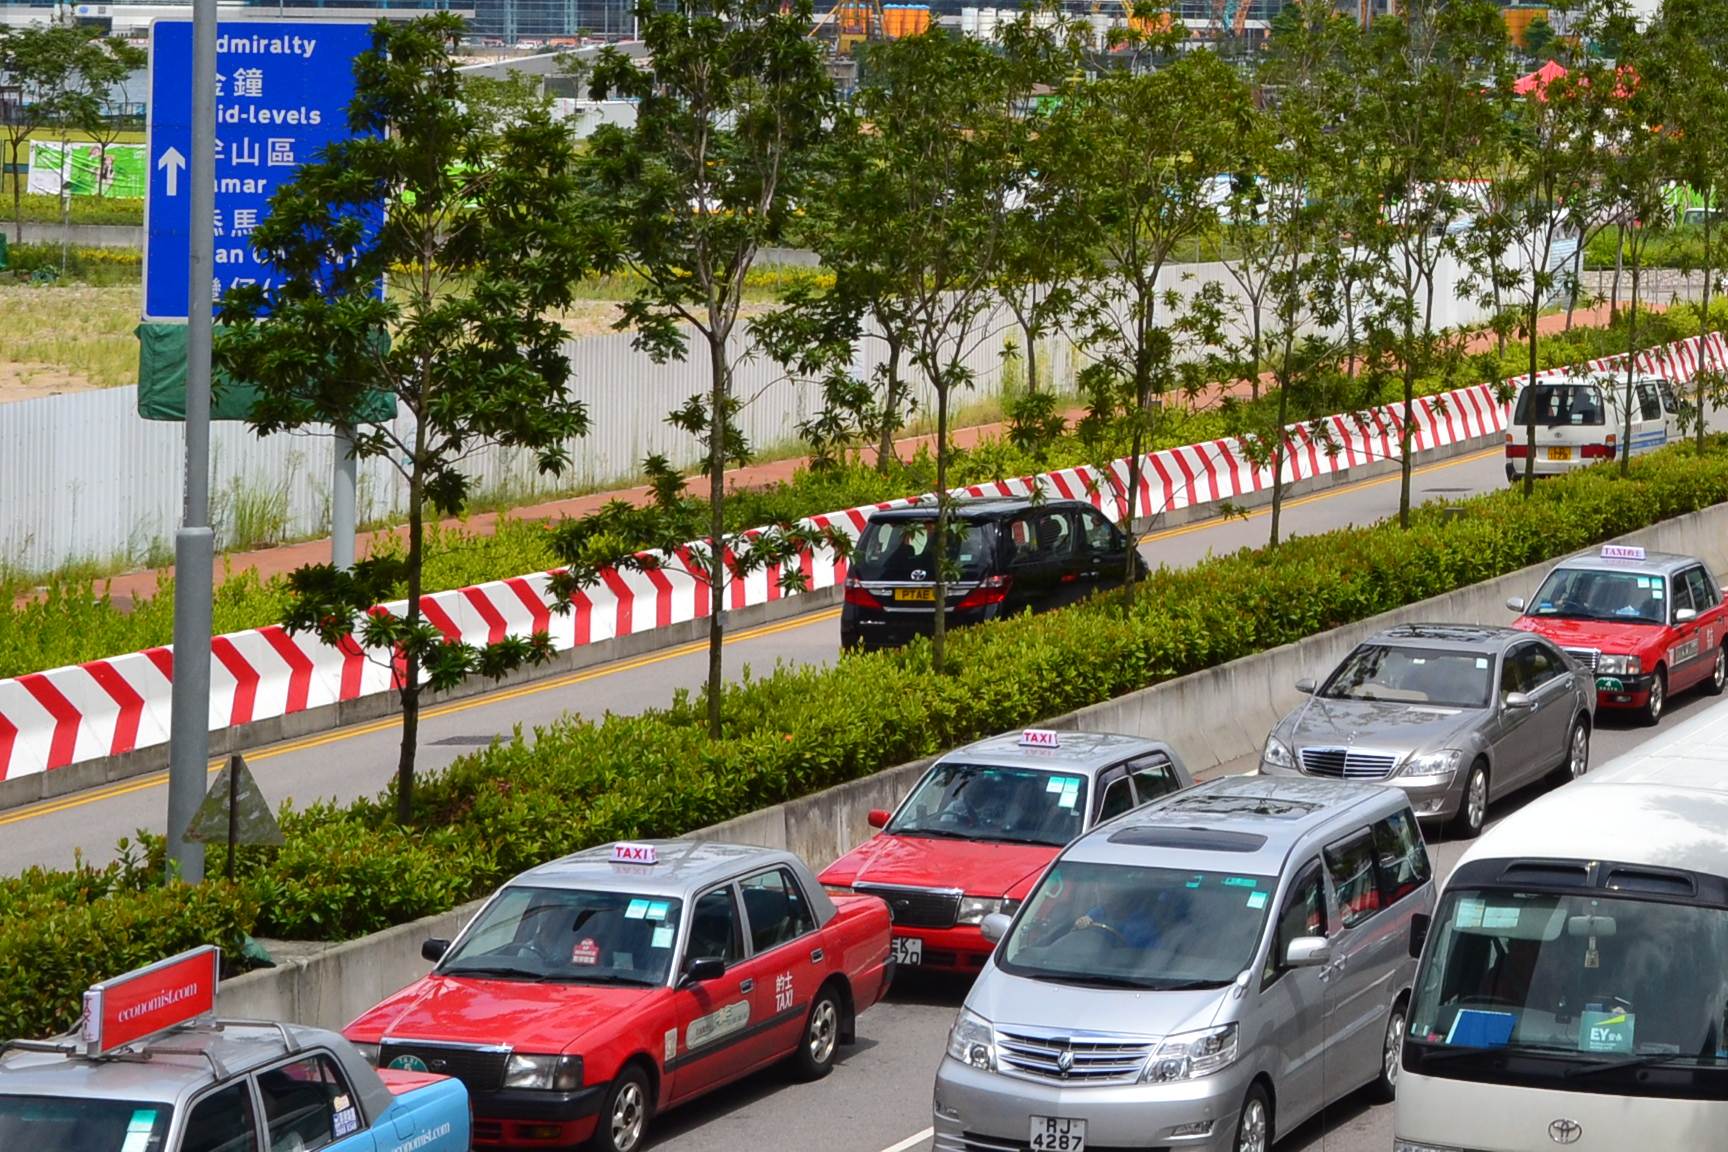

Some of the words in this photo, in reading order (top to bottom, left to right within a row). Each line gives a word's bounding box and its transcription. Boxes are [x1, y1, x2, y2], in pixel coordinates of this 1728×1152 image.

[216, 34, 316, 58] dmiralty
[217, 104, 322, 126] id-levels
[214, 178, 268, 194] mar
[1024, 732, 1052, 744] TAXI
[615, 846, 648, 860] TAXI
[118, 983, 198, 1023] economist.com
[776, 990, 794, 1013] TAXI
[1590, 1027, 1611, 1041] EY
[1046, 1118, 1071, 1135] RJ
[391, 1122, 450, 1152] conomist.com
[1033, 1133, 1082, 1151] 4287
